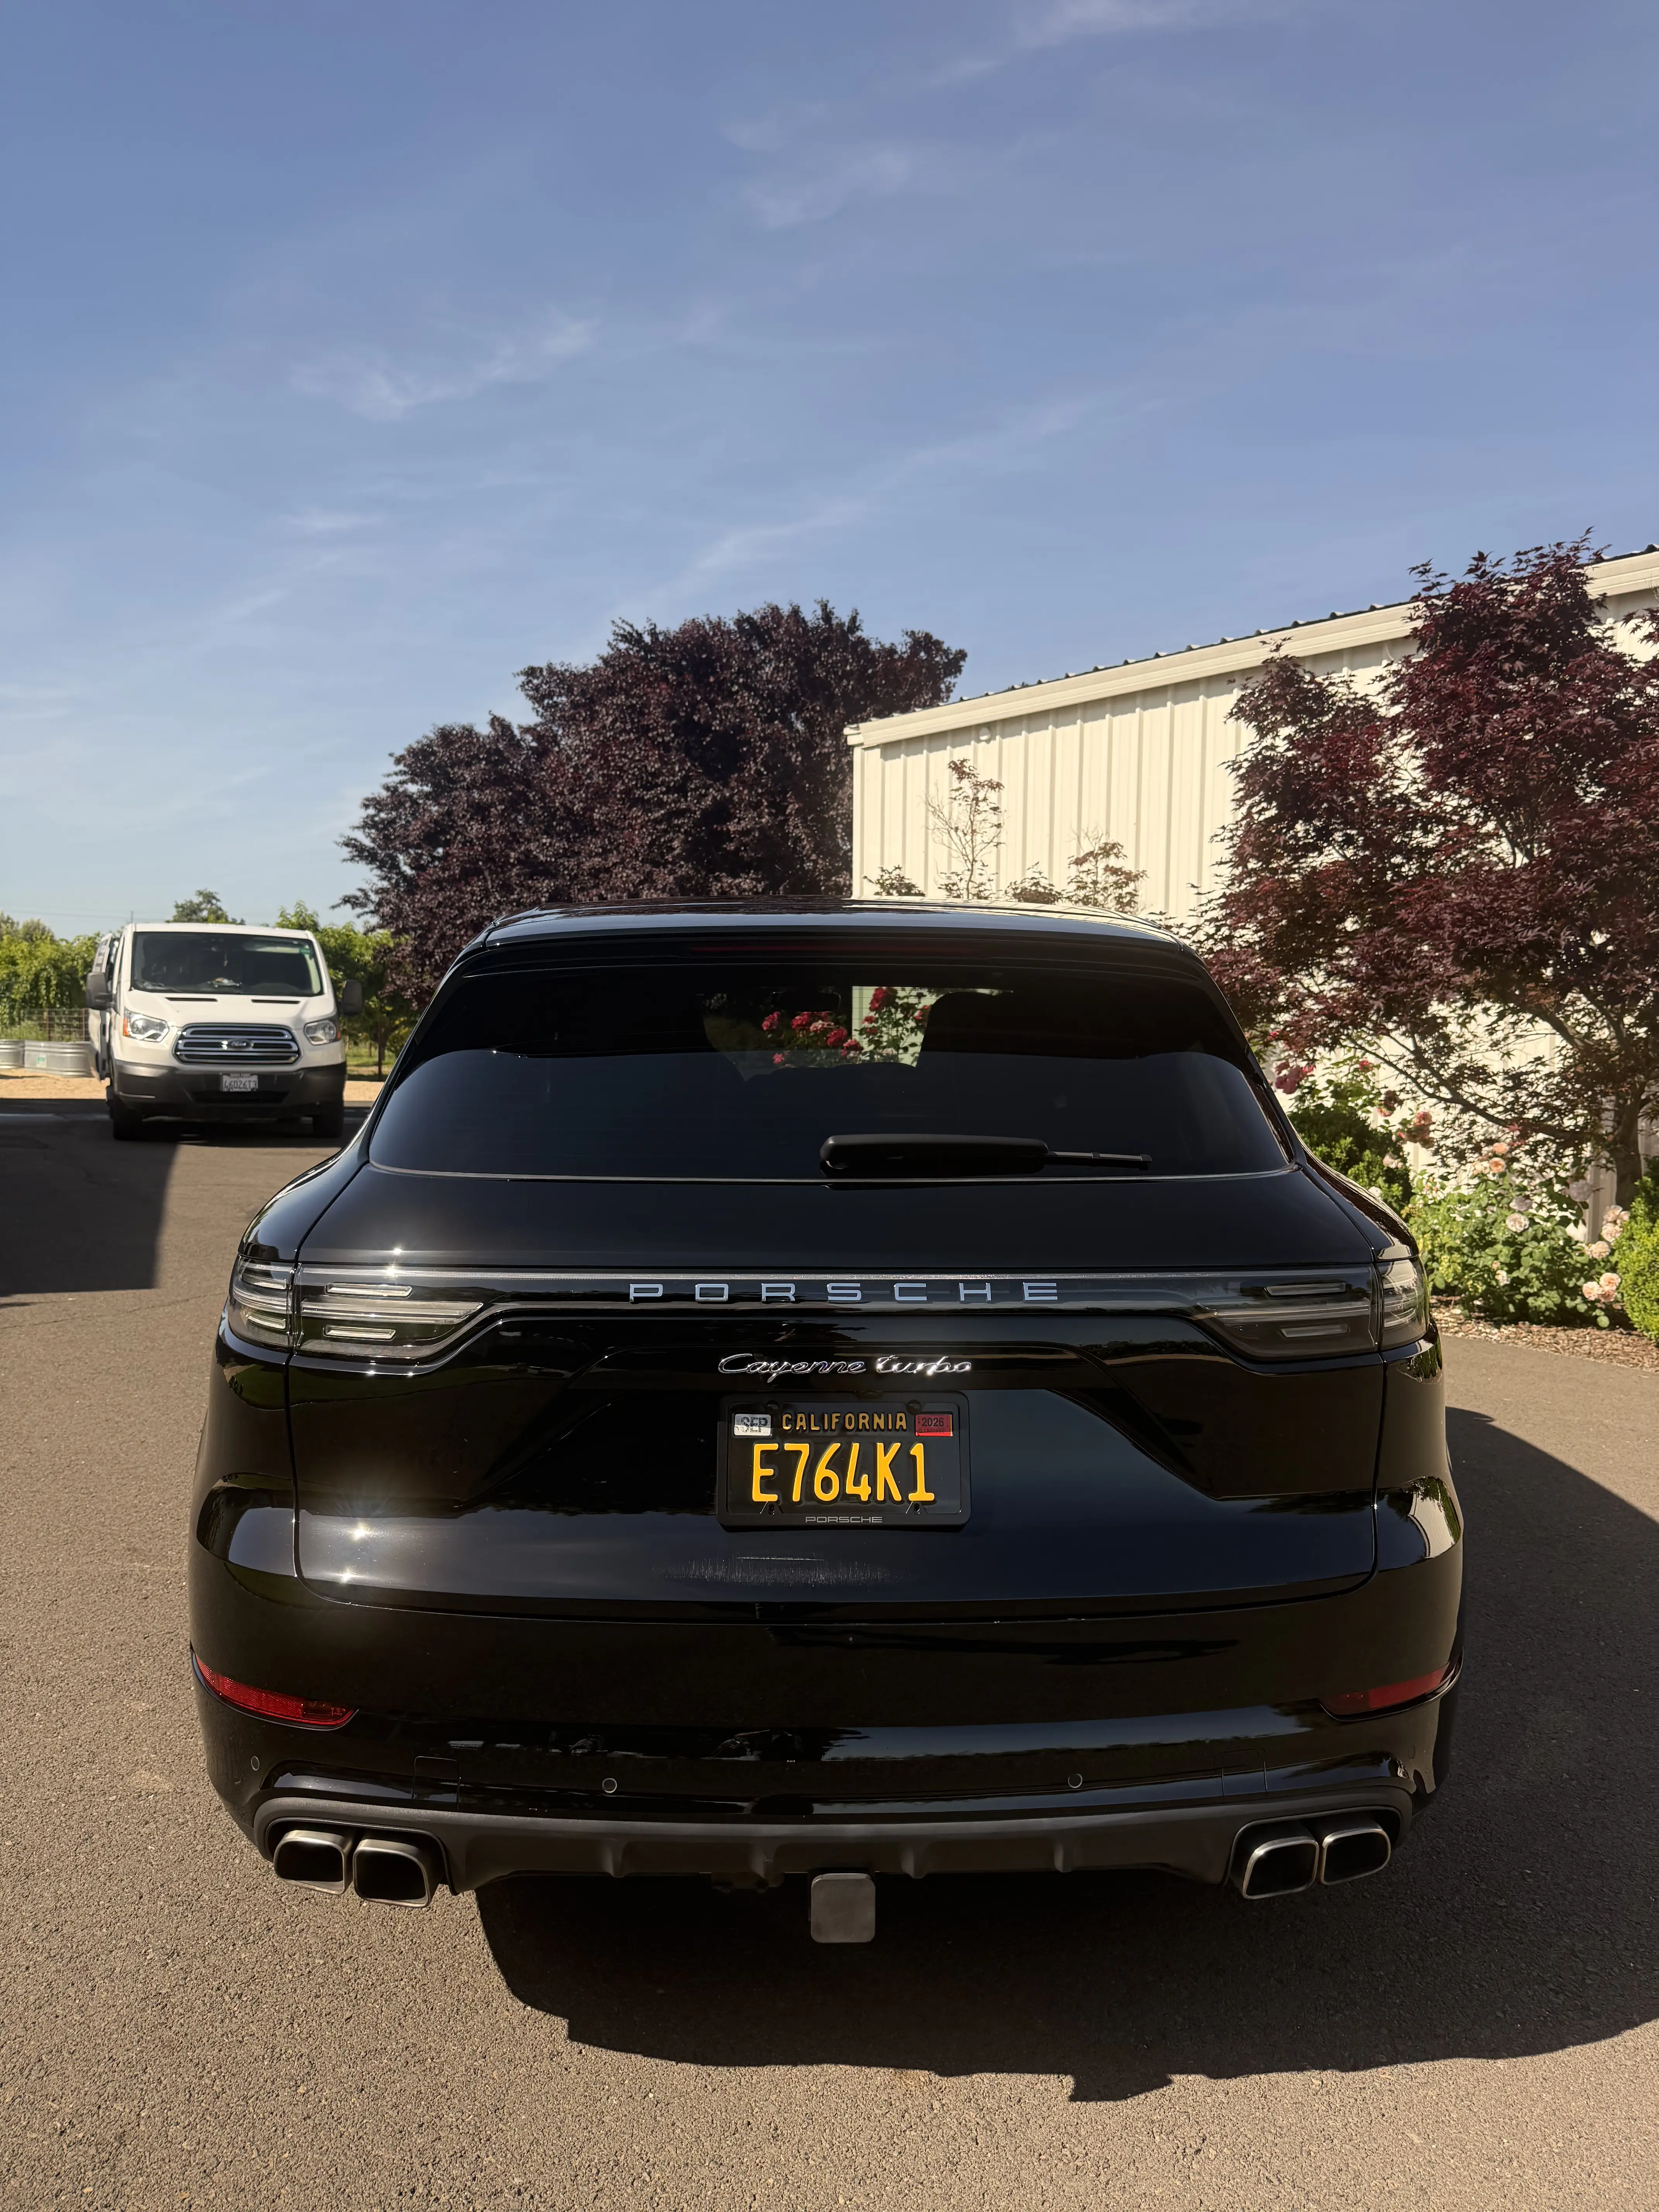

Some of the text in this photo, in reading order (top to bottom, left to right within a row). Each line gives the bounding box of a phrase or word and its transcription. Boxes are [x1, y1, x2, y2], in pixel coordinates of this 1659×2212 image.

[630, 1282, 1058, 1302] PORSCHE
[718, 1353, 972, 1383] Cayenne turbo
[741, 1416, 768, 1433] SEP
[782, 1412, 907, 1430] CALIFORNIA
[921, 1417, 944, 1427] 2026
[752, 1442, 935, 1502] E764K1
